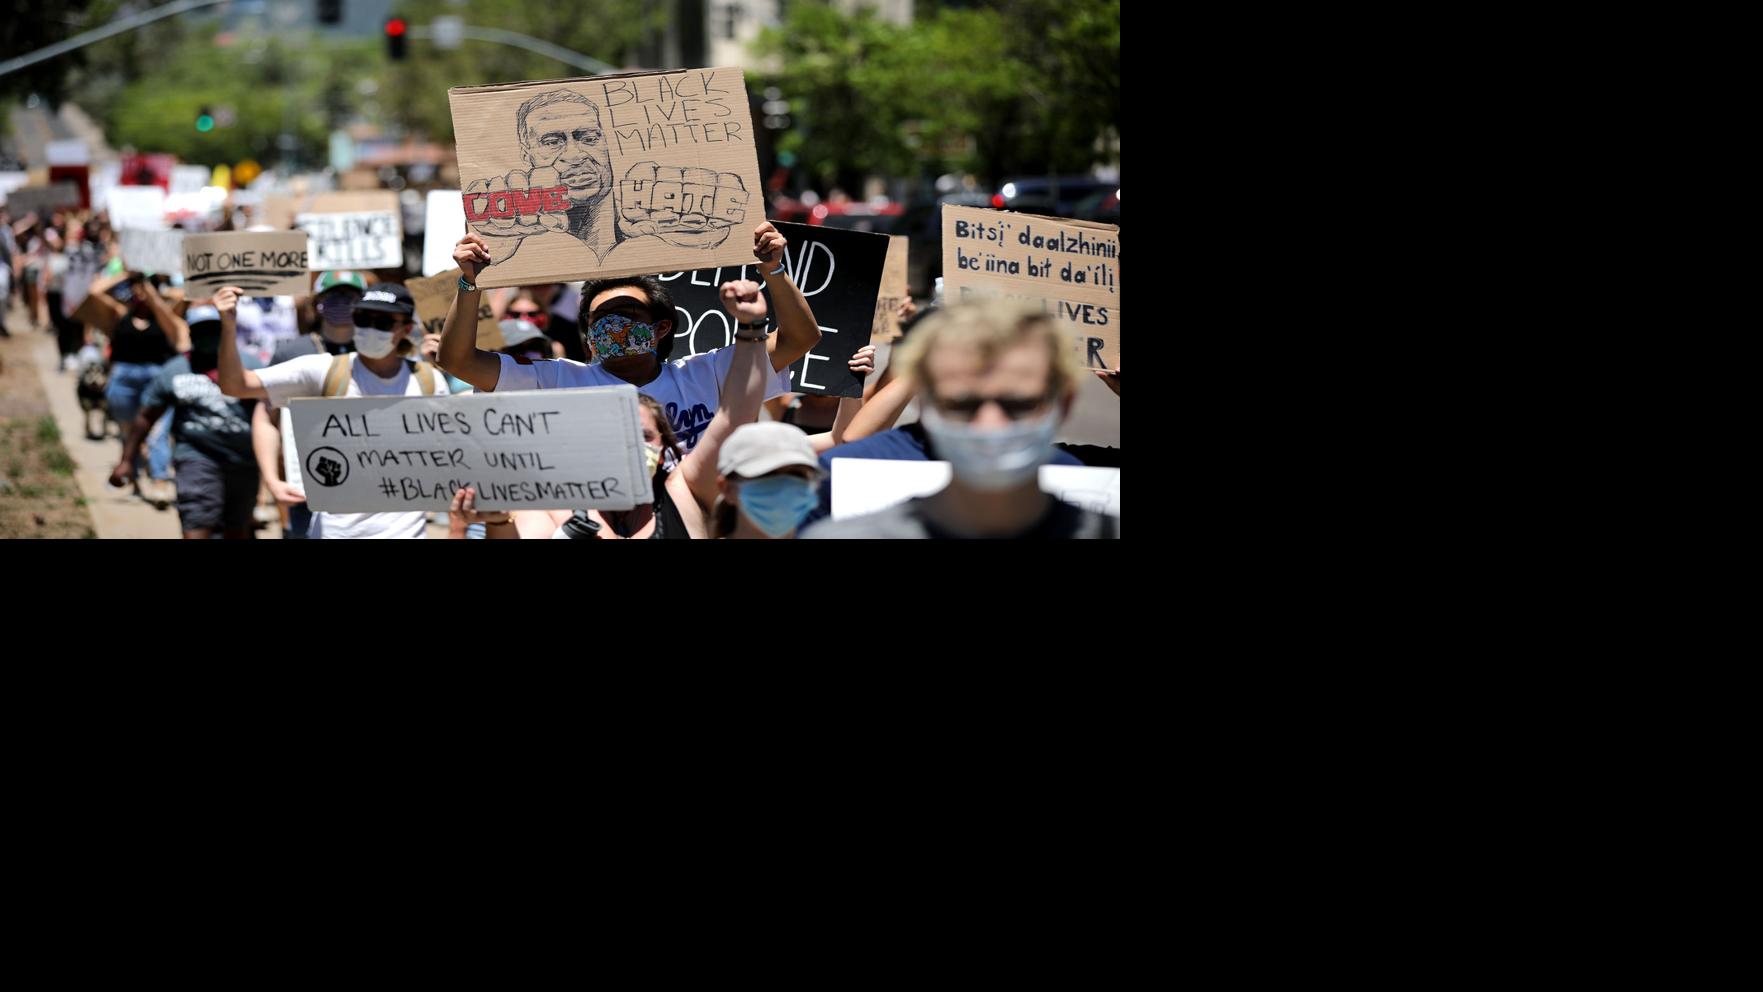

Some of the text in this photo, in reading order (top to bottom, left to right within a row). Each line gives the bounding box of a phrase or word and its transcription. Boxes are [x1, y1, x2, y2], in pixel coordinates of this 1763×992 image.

[603, 72, 729, 107] BLACK
[610, 98, 732, 128] LIVES
[615, 122, 743, 156] MATTER
[463, 185, 572, 222] LOVE
[620, 179, 750, 225] HATE
[316, 238, 386, 264] KILLS
[1019, 225, 1116, 259] daalzhinii
[187, 250, 308, 271] NOT ONE MORE
[321, 408, 560, 438] ALL LIVES CAN'T
[357, 448, 556, 471] MATTER UNTIL
